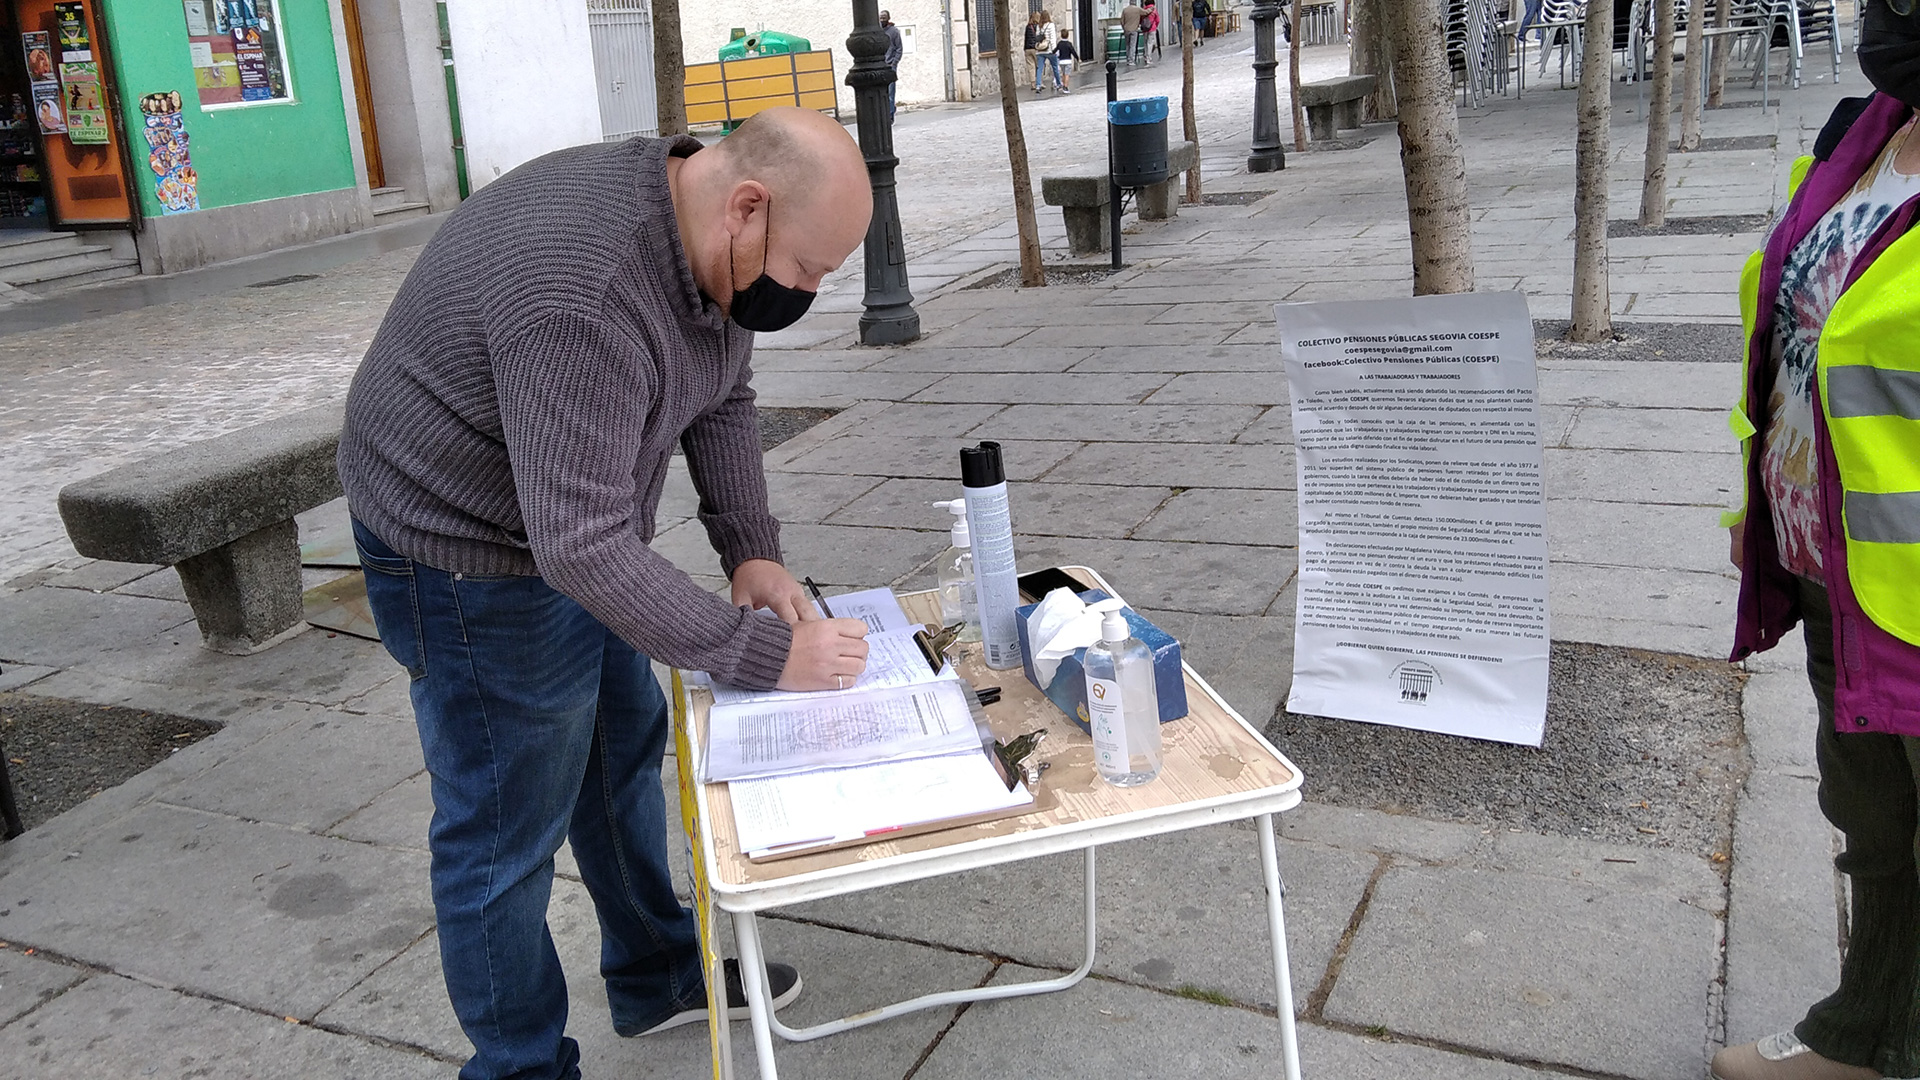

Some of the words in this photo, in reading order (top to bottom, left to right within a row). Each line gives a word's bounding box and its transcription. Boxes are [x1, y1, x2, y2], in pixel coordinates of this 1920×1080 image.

[1297, 338, 1341, 347] COLECTIVO
[1344, 336, 1386, 344] PENSIONES
[1388, 334, 1427, 342] PÚBLICAS
[1344, 345, 1453, 355] coespesegovia@gmail.com
[1303, 357, 1382, 368] facebook:Colectivo
[1462, 355, 1500, 364] (COESPE)
[1418, 396, 1436, 404] algunas
[1487, 396, 1511, 405] plantean
[1349, 404, 1368, 412] después
[1384, 404, 1402, 412] algunas
[1446, 405, 1470, 414] diputados
[1483, 406, 1506, 414] respecto
[1514, 521, 1541, 530] impropios
[1333, 541, 1366, 550] declaraciones
[1404, 545, 1432, 554] Magdalena
[1433, 548, 1452, 556] Valerio,
[1393, 585, 1414, 593] pedimos
[1360, 624, 1391, 634] trabajadores
[1396, 628, 1428, 637] trabajadoras
[1386, 645, 1414, 655] GOBIERNE,
[1428, 650, 1458, 659] PENSIONES
